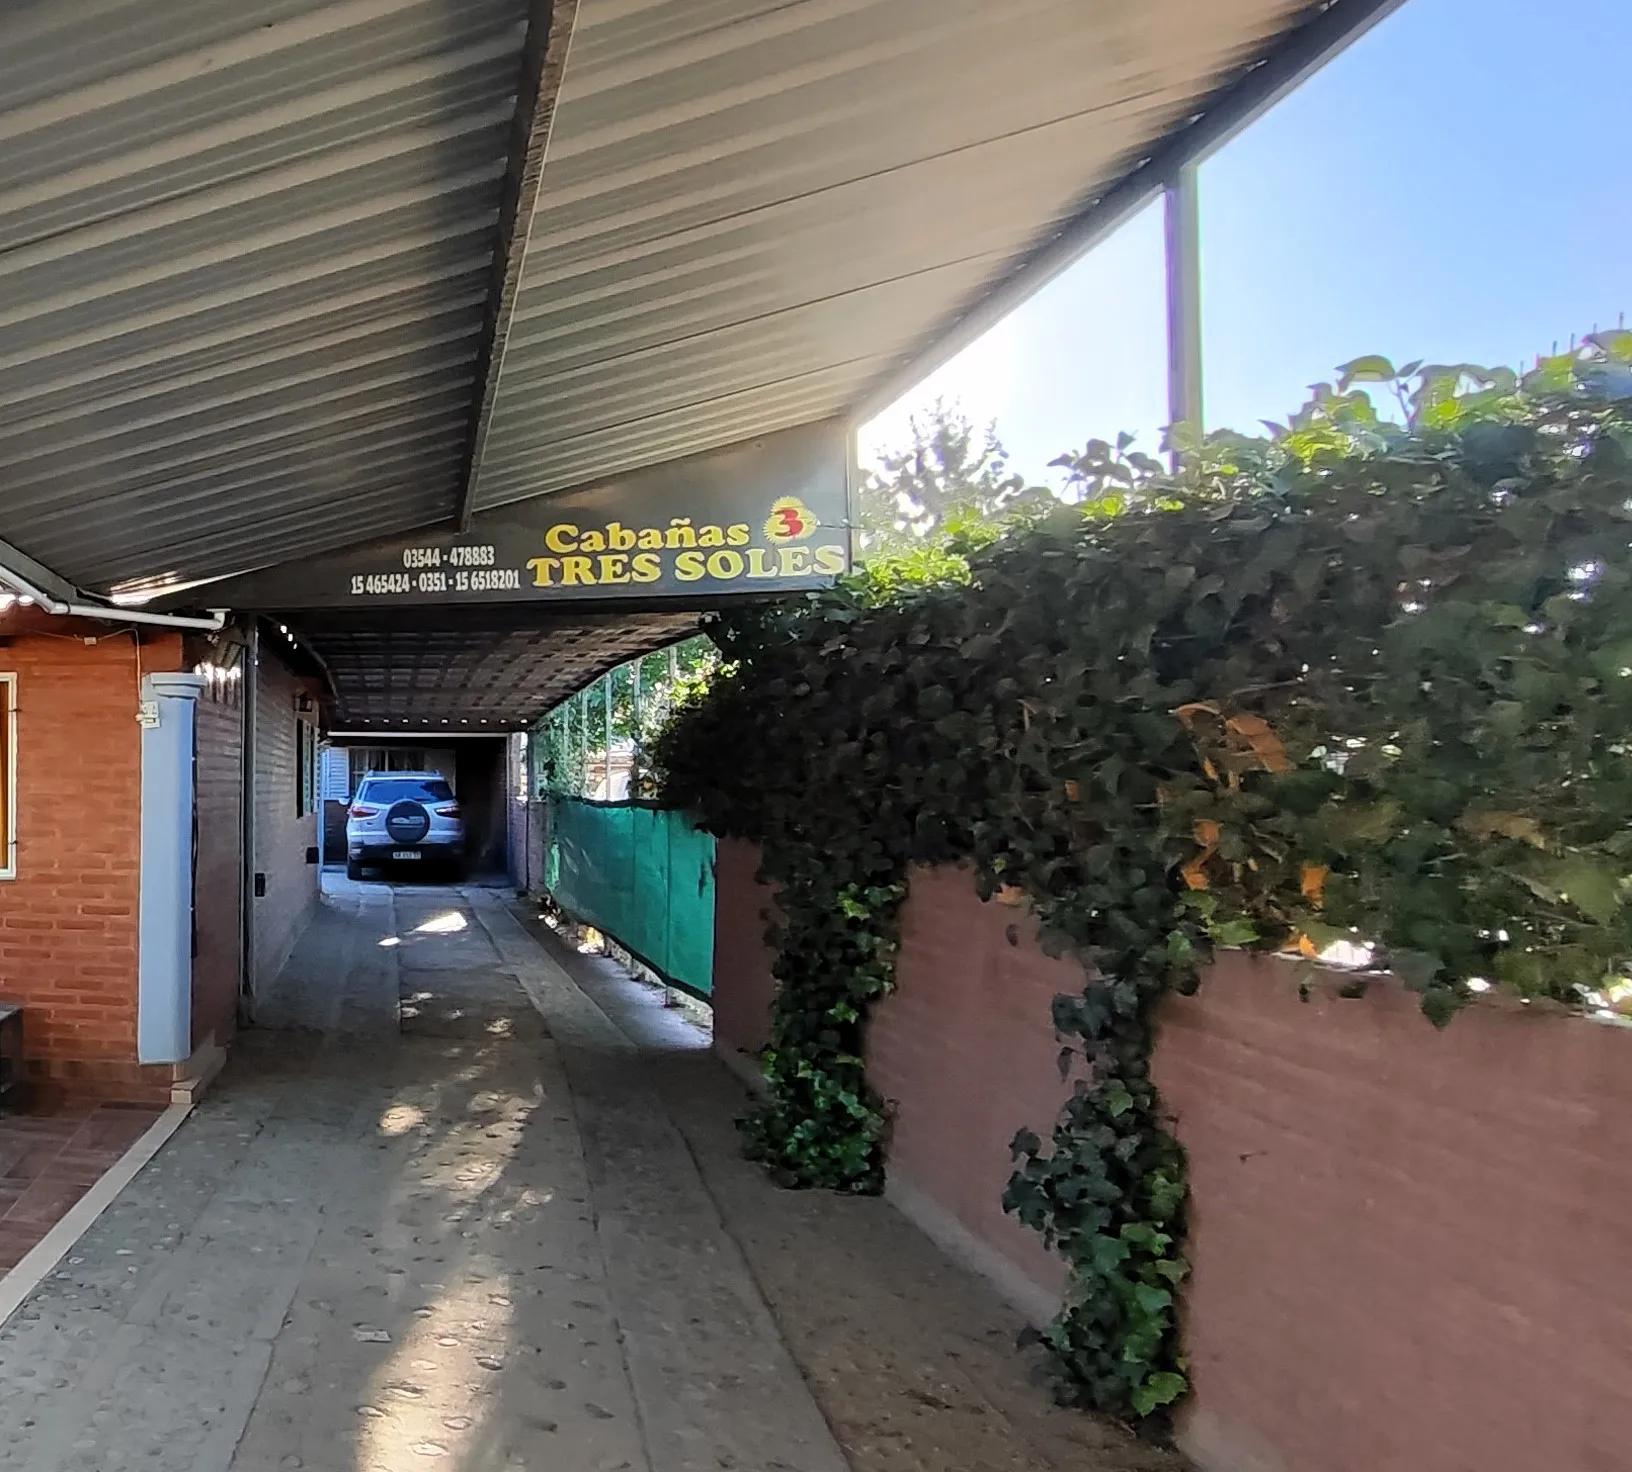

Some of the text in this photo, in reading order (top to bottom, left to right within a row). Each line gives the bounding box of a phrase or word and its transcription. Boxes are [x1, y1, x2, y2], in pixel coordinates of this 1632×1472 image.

[545, 517, 750, 553] Cabañas
[402, 545, 495, 569] 03544 478883
[526, 545, 846, 588] TRES SOLES
[350, 568, 520, 595] 15 465424 0351 15 6518201
